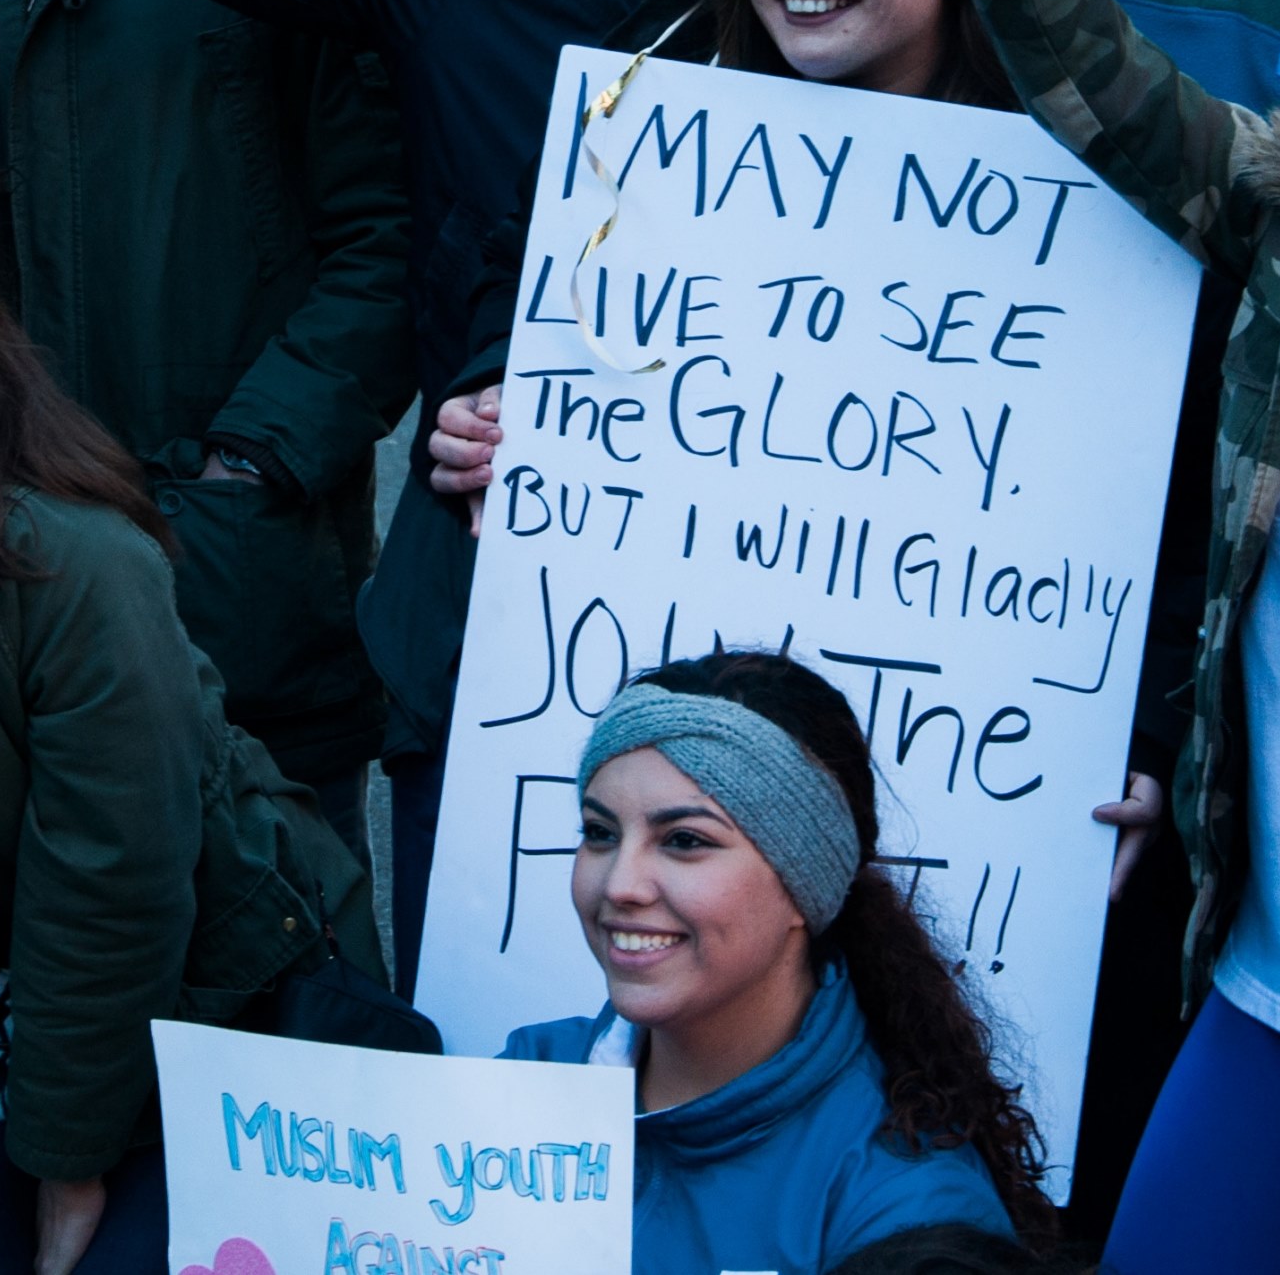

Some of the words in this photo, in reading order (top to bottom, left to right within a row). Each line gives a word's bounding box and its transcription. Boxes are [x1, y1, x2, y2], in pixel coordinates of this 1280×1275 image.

[562, 71, 588, 200] I
[617, 103, 853, 230] MAY
[892, 153, 1097, 266] NOT
[525, 255, 723, 348] LIVE
[758, 275, 844, 343] TO
[880, 281, 1068, 369] SEE
[514, 368, 646, 463] The
[669, 354, 1022, 513] GLORY.
[503, 464, 644, 552] BUT
[683, 503, 698, 559] I
[893, 531, 1133, 694] Gladly
[222, 1092, 407, 1195] MUSLIM
